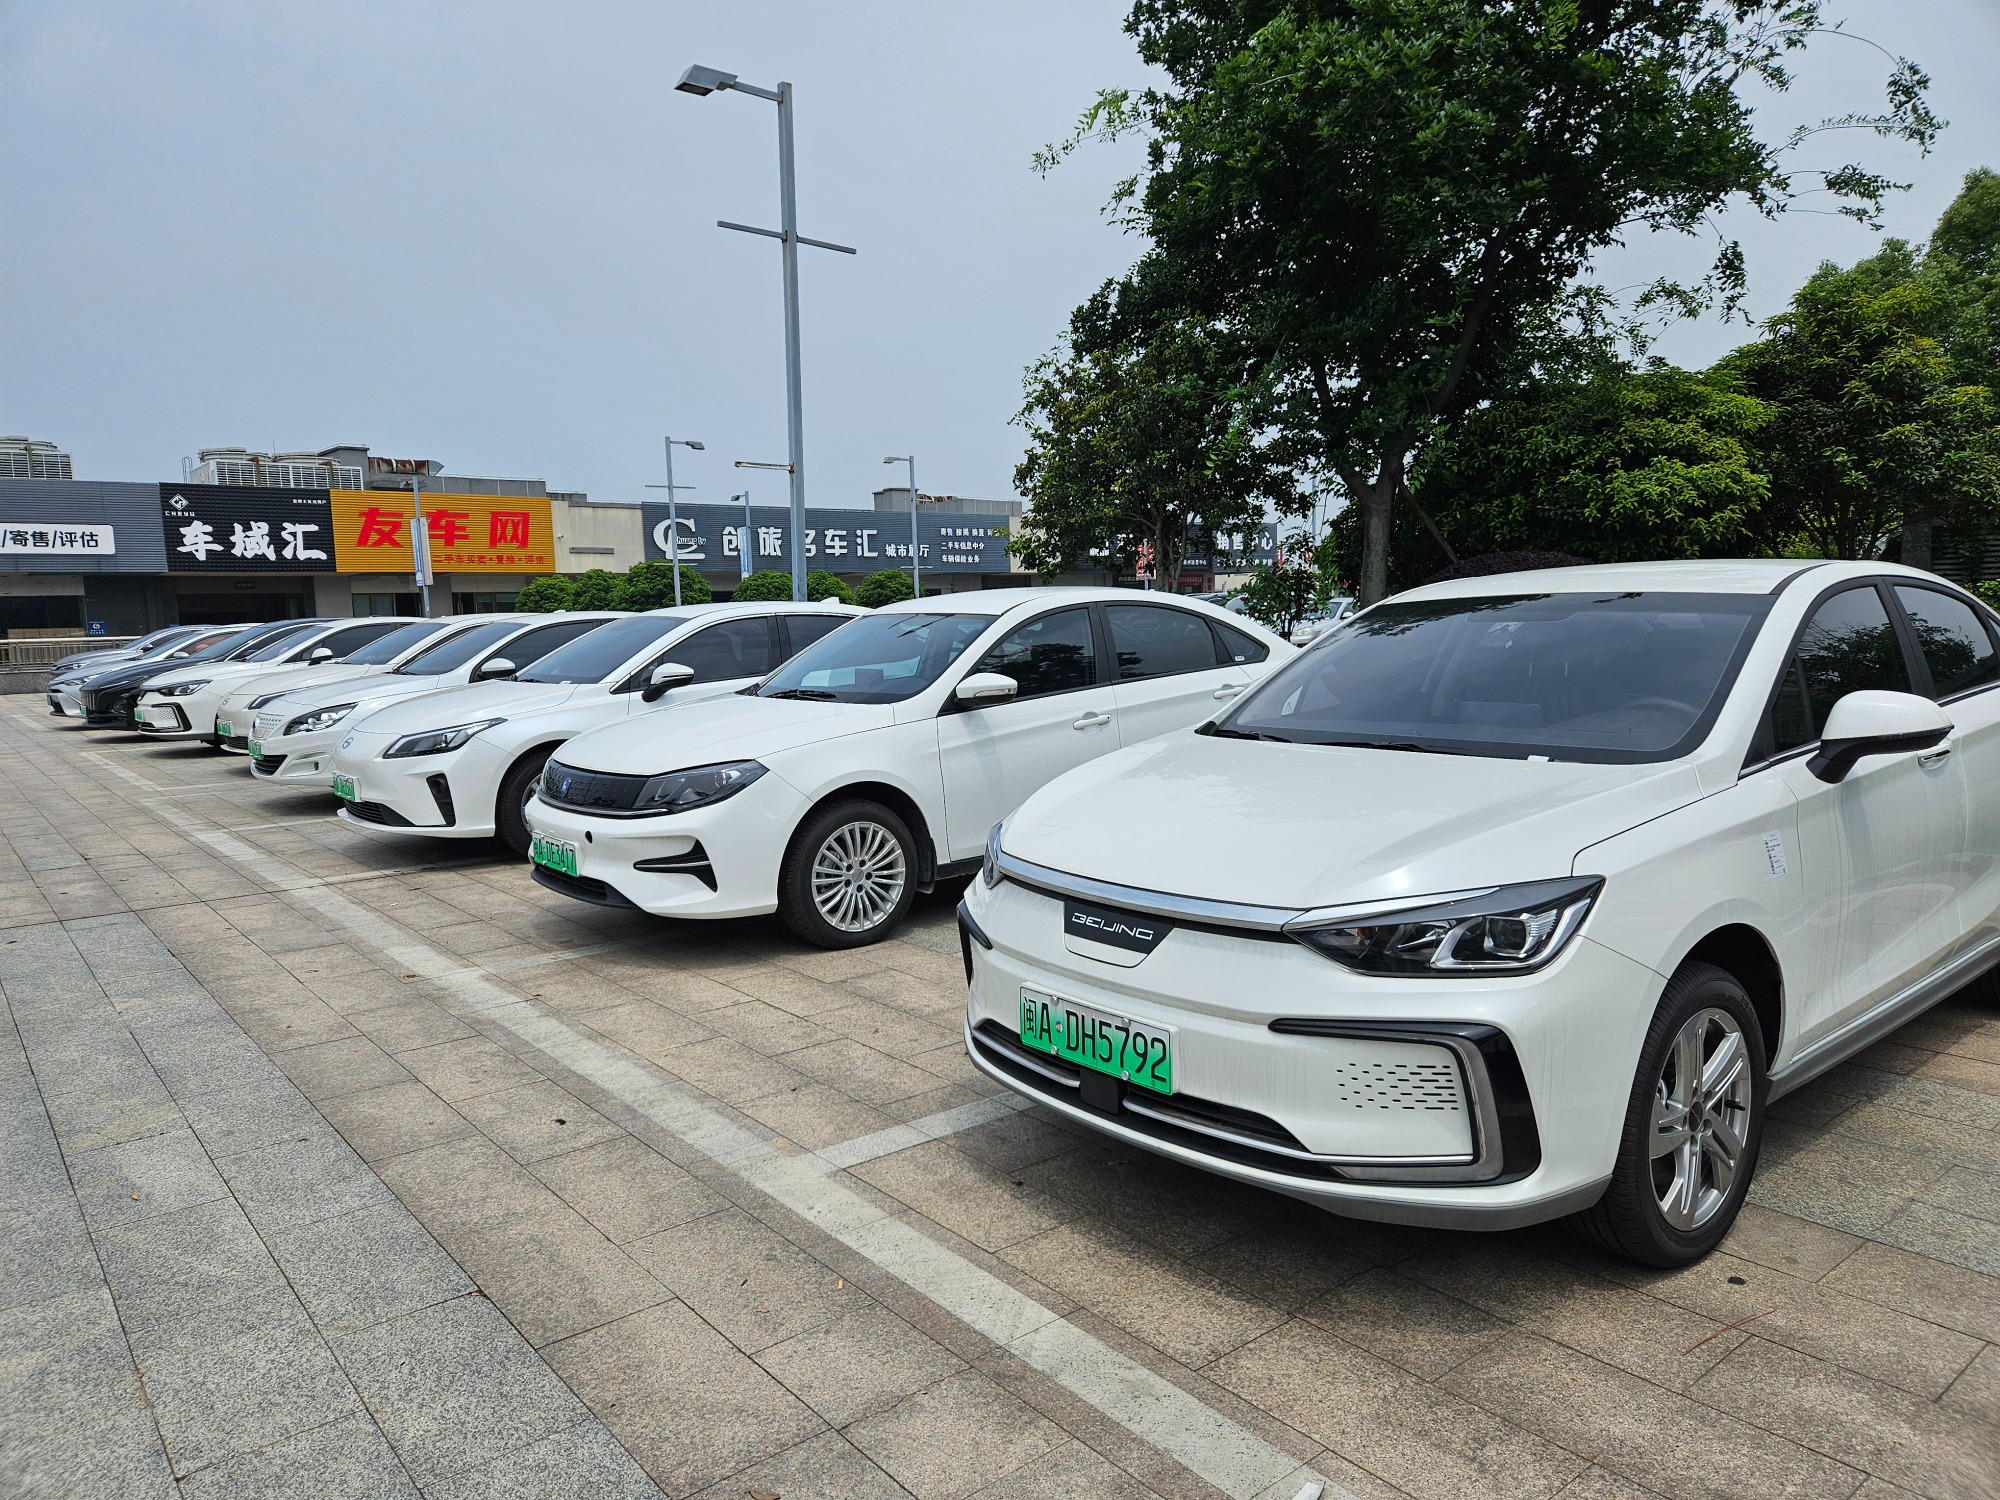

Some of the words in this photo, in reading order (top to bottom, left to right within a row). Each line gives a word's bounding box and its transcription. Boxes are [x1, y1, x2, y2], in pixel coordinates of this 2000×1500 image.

[355, 506, 530, 549] 友车网
[941, 541, 985, 550] 二手车信息中介
[942, 555, 980, 563] 车辆保险业务
[1072, 912, 1154, 940] BEIJING
